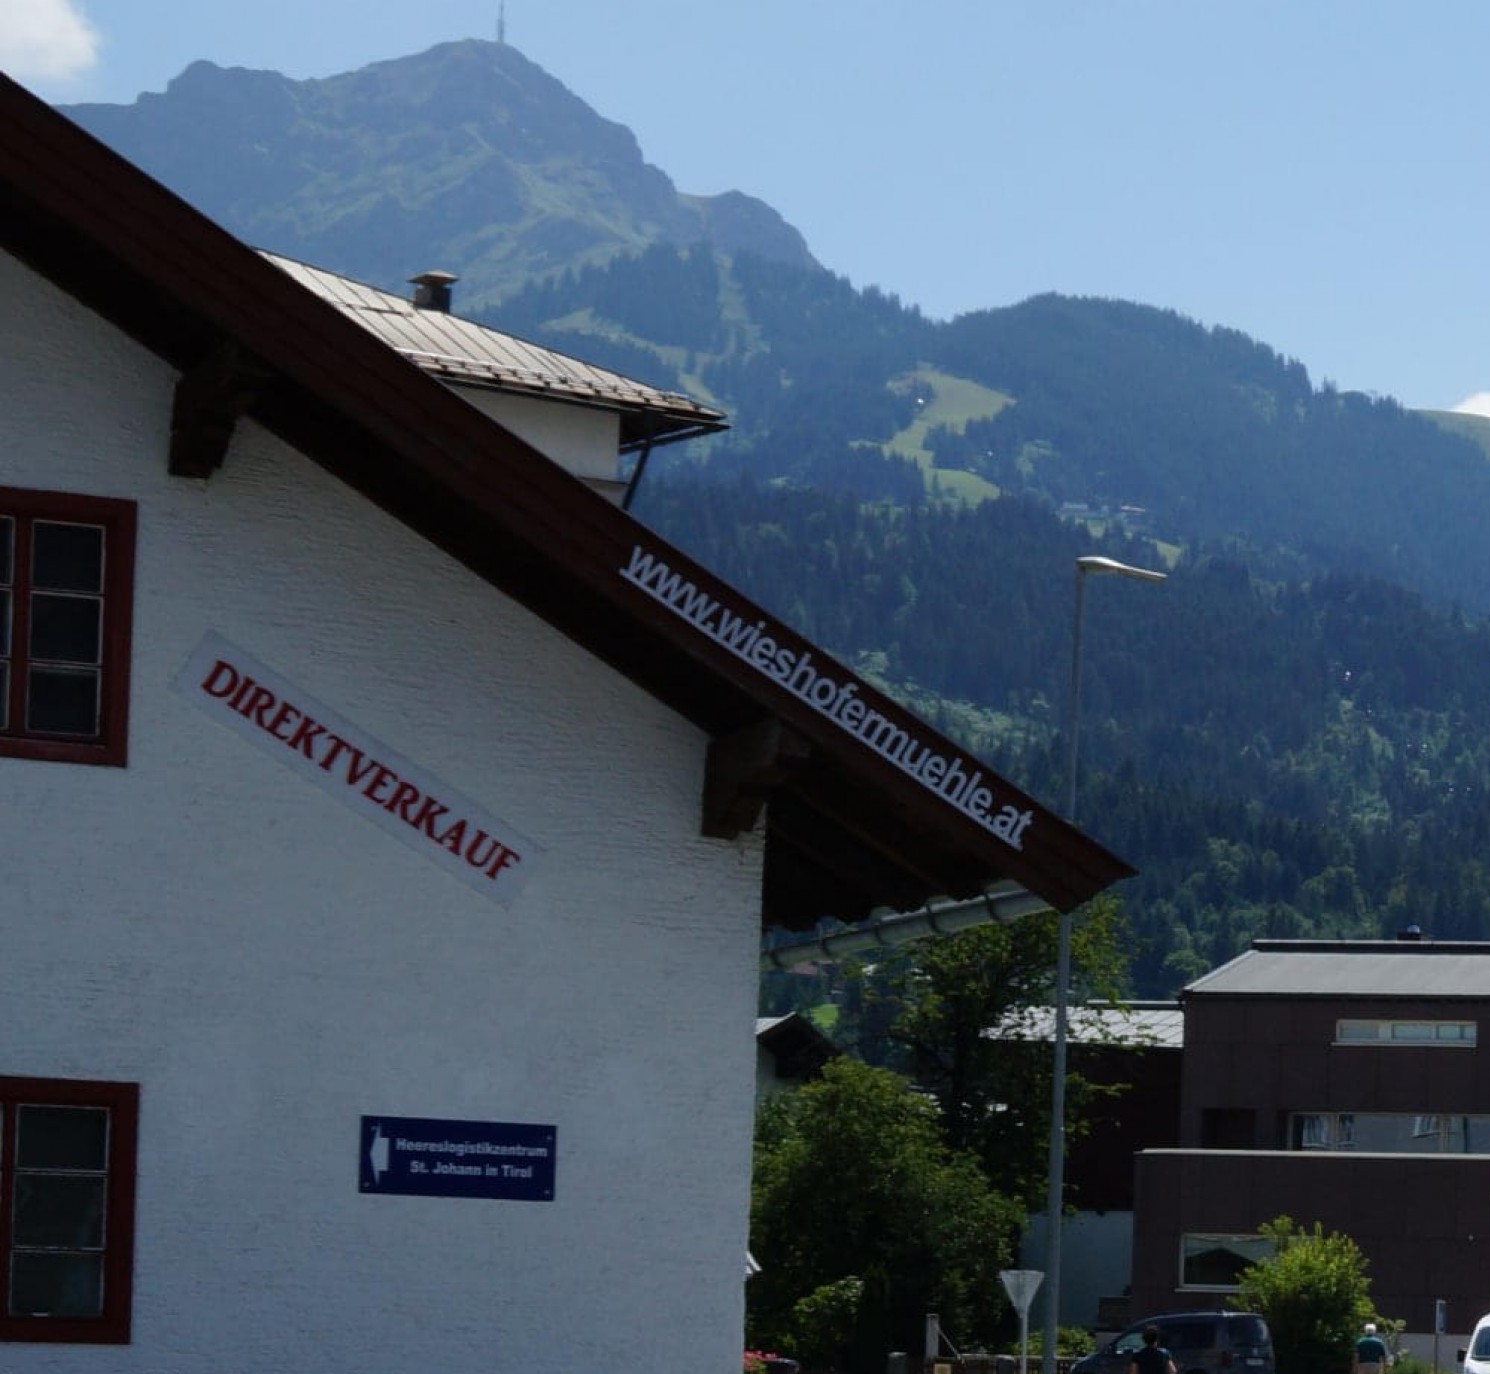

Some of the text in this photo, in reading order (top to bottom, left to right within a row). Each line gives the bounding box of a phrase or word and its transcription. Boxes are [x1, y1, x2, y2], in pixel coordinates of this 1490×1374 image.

[619, 545, 1034, 852] www.wieshofermuehle.at
[202, 659, 521, 881] DIREKTVERKAUF
[396, 1137, 548, 1157] Heereslogistikzentrum
[410, 1160, 533, 1179] St. Johann in Tirol
